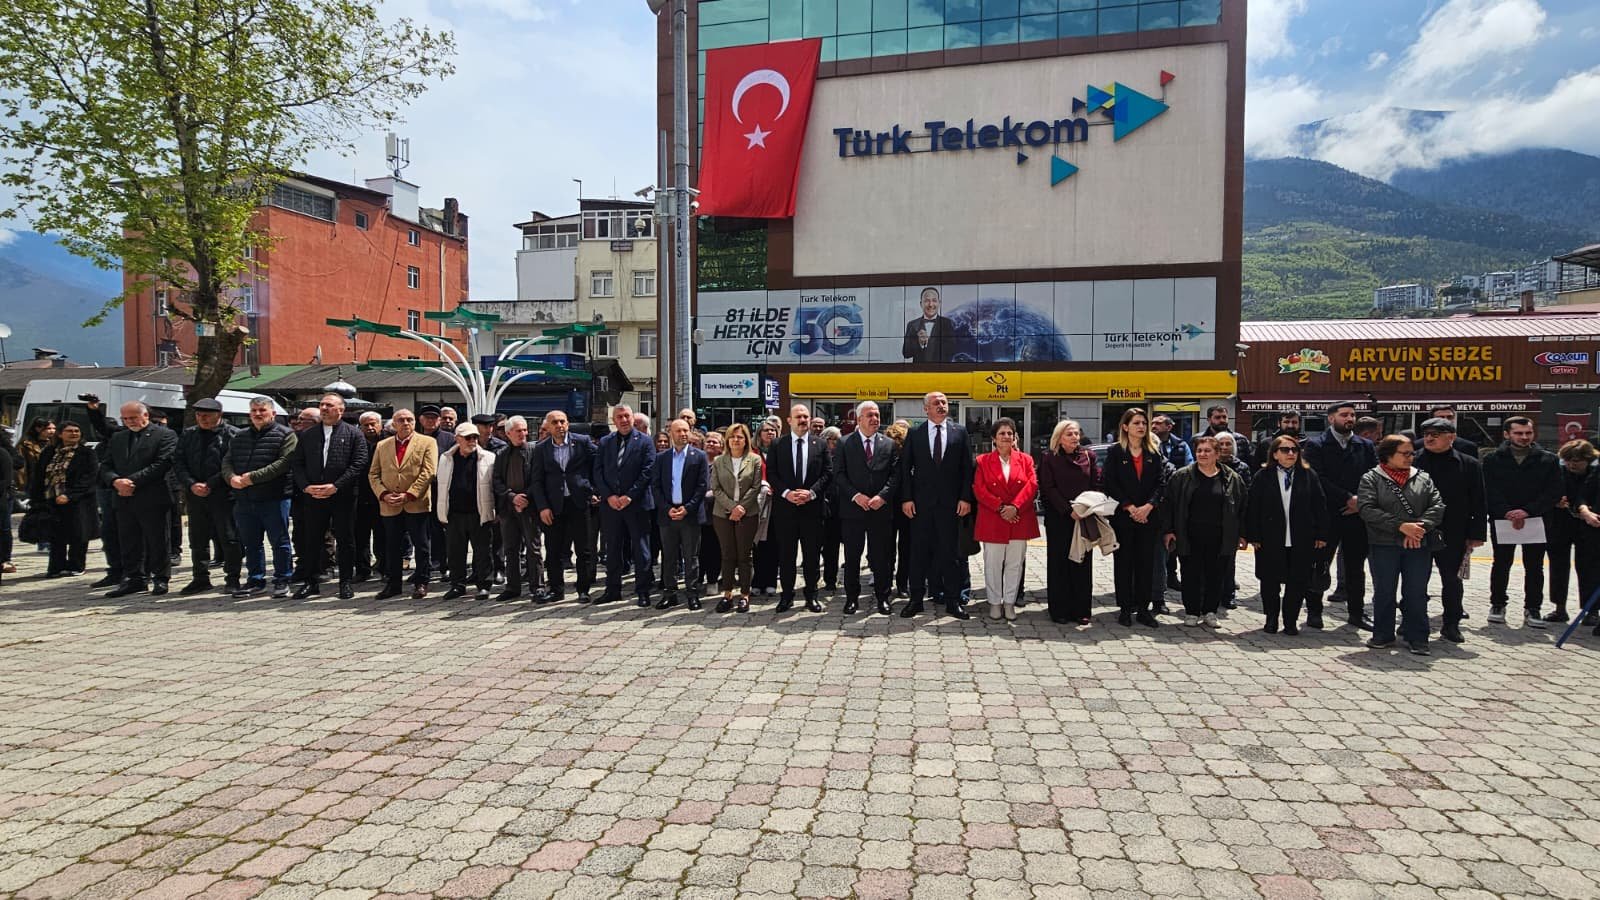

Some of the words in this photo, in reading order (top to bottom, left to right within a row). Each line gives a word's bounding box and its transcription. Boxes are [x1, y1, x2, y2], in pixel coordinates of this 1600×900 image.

[833, 124, 912, 158] Türk
[925, 115, 1089, 153] Telekom
[800, 295, 818, 303] Türk
[821, 294, 857, 303] Telekom
[726, 308, 744, 322] 81
[713, 325, 786, 339] HERKES
[789, 305, 864, 356] 5G
[1104, 332, 1129, 342] Türk
[1133, 332, 1182, 342] Telekom
[1429, 346, 1493, 361] SEBZE
[1299, 371, 1309, 384] 2
[1340, 367, 1405, 382] MEYVE
[1412, 363, 1502, 381] DÜNYASI
[997, 384, 1008, 393] Ptt
[1111, 388, 1142, 398] PttBank
[1456, 403, 1483, 411] MEYVE
[1490, 403, 1527, 411] DÜNYASI
